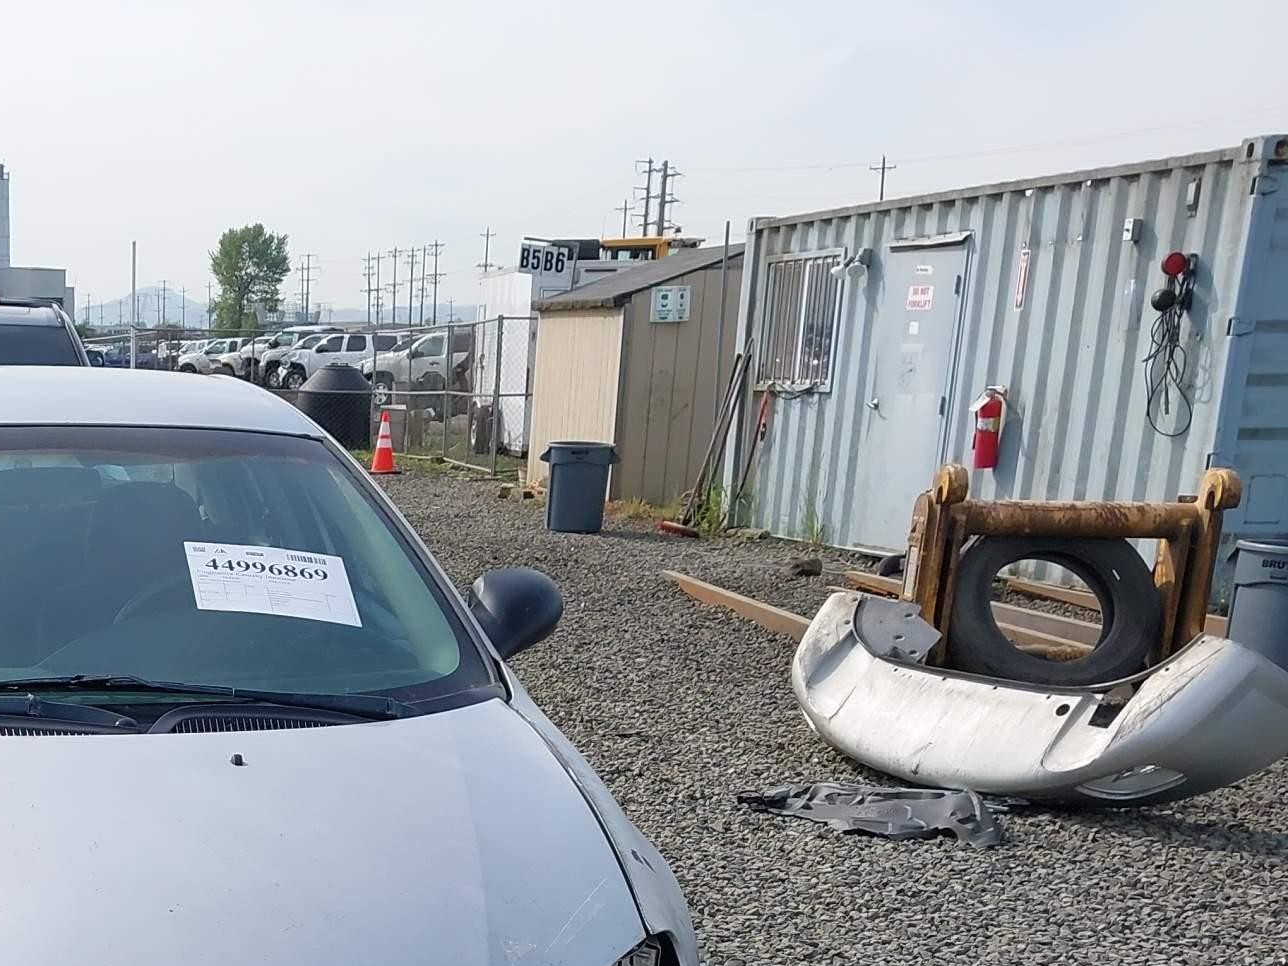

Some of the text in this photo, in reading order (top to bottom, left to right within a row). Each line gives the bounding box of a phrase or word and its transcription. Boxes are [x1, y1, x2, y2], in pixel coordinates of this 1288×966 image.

[521, 247, 565, 272] B5 B6
[205, 558, 328, 581] 44996869
